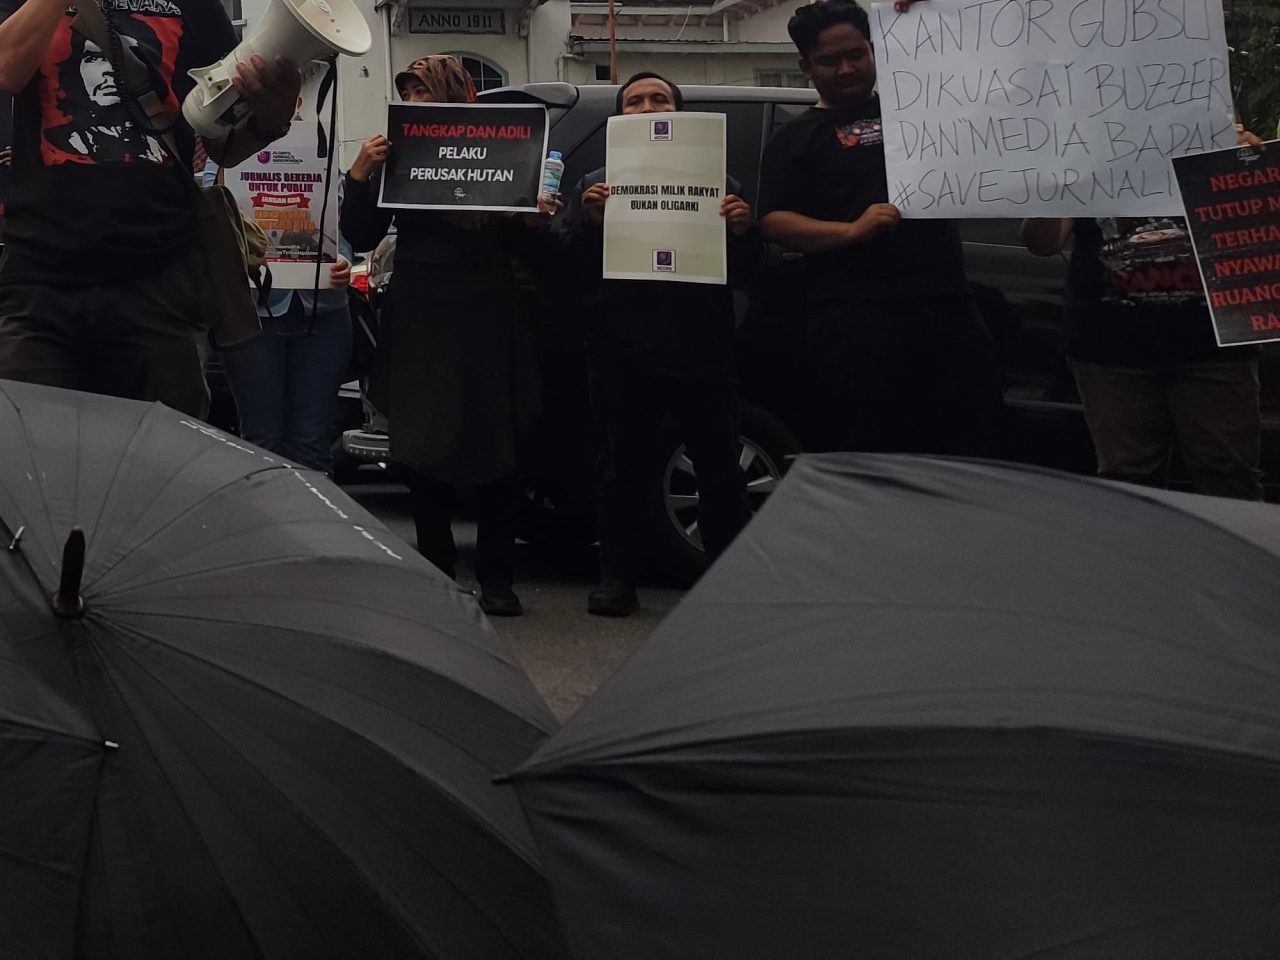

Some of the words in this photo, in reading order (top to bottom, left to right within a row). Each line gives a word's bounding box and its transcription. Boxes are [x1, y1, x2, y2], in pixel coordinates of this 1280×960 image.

[418, 13, 461, 28] ANNO
[467, 15, 492, 28] 1911
[892, 61, 1075, 112] DIKUASAI
[1084, 57, 1231, 118] BUZZER
[401, 122, 465, 138] TANGKAP
[466, 124, 497, 139] DAN
[497, 124, 533, 140] ADILI
[1103, 121, 1233, 163] BAPAK
[438, 146, 487, 160] PELAKU
[240, 172, 282, 182] JURNALIS
[283, 172, 323, 183] BEKERJA
[410, 167, 466, 182] PERUSAK
[467, 169, 514, 182] HUTAN
[1209, 165, 1280, 192] NEGAR
[248, 183, 279, 192] UNTUK
[280, 183, 314, 193] PUBLIK
[610, 185, 659, 196] DEMOKRASI
[661, 186, 686, 196] MILIK
[688, 186, 720, 198] RAKYAT
[893, 167, 1174, 211] #SAVEJURNALI
[630, 200, 658, 210] BUKAN
[660, 200, 700, 212] OLIGARKI
[1195, 198, 1264, 223] TUTUP
[1211, 224, 1280, 250] TERHA
